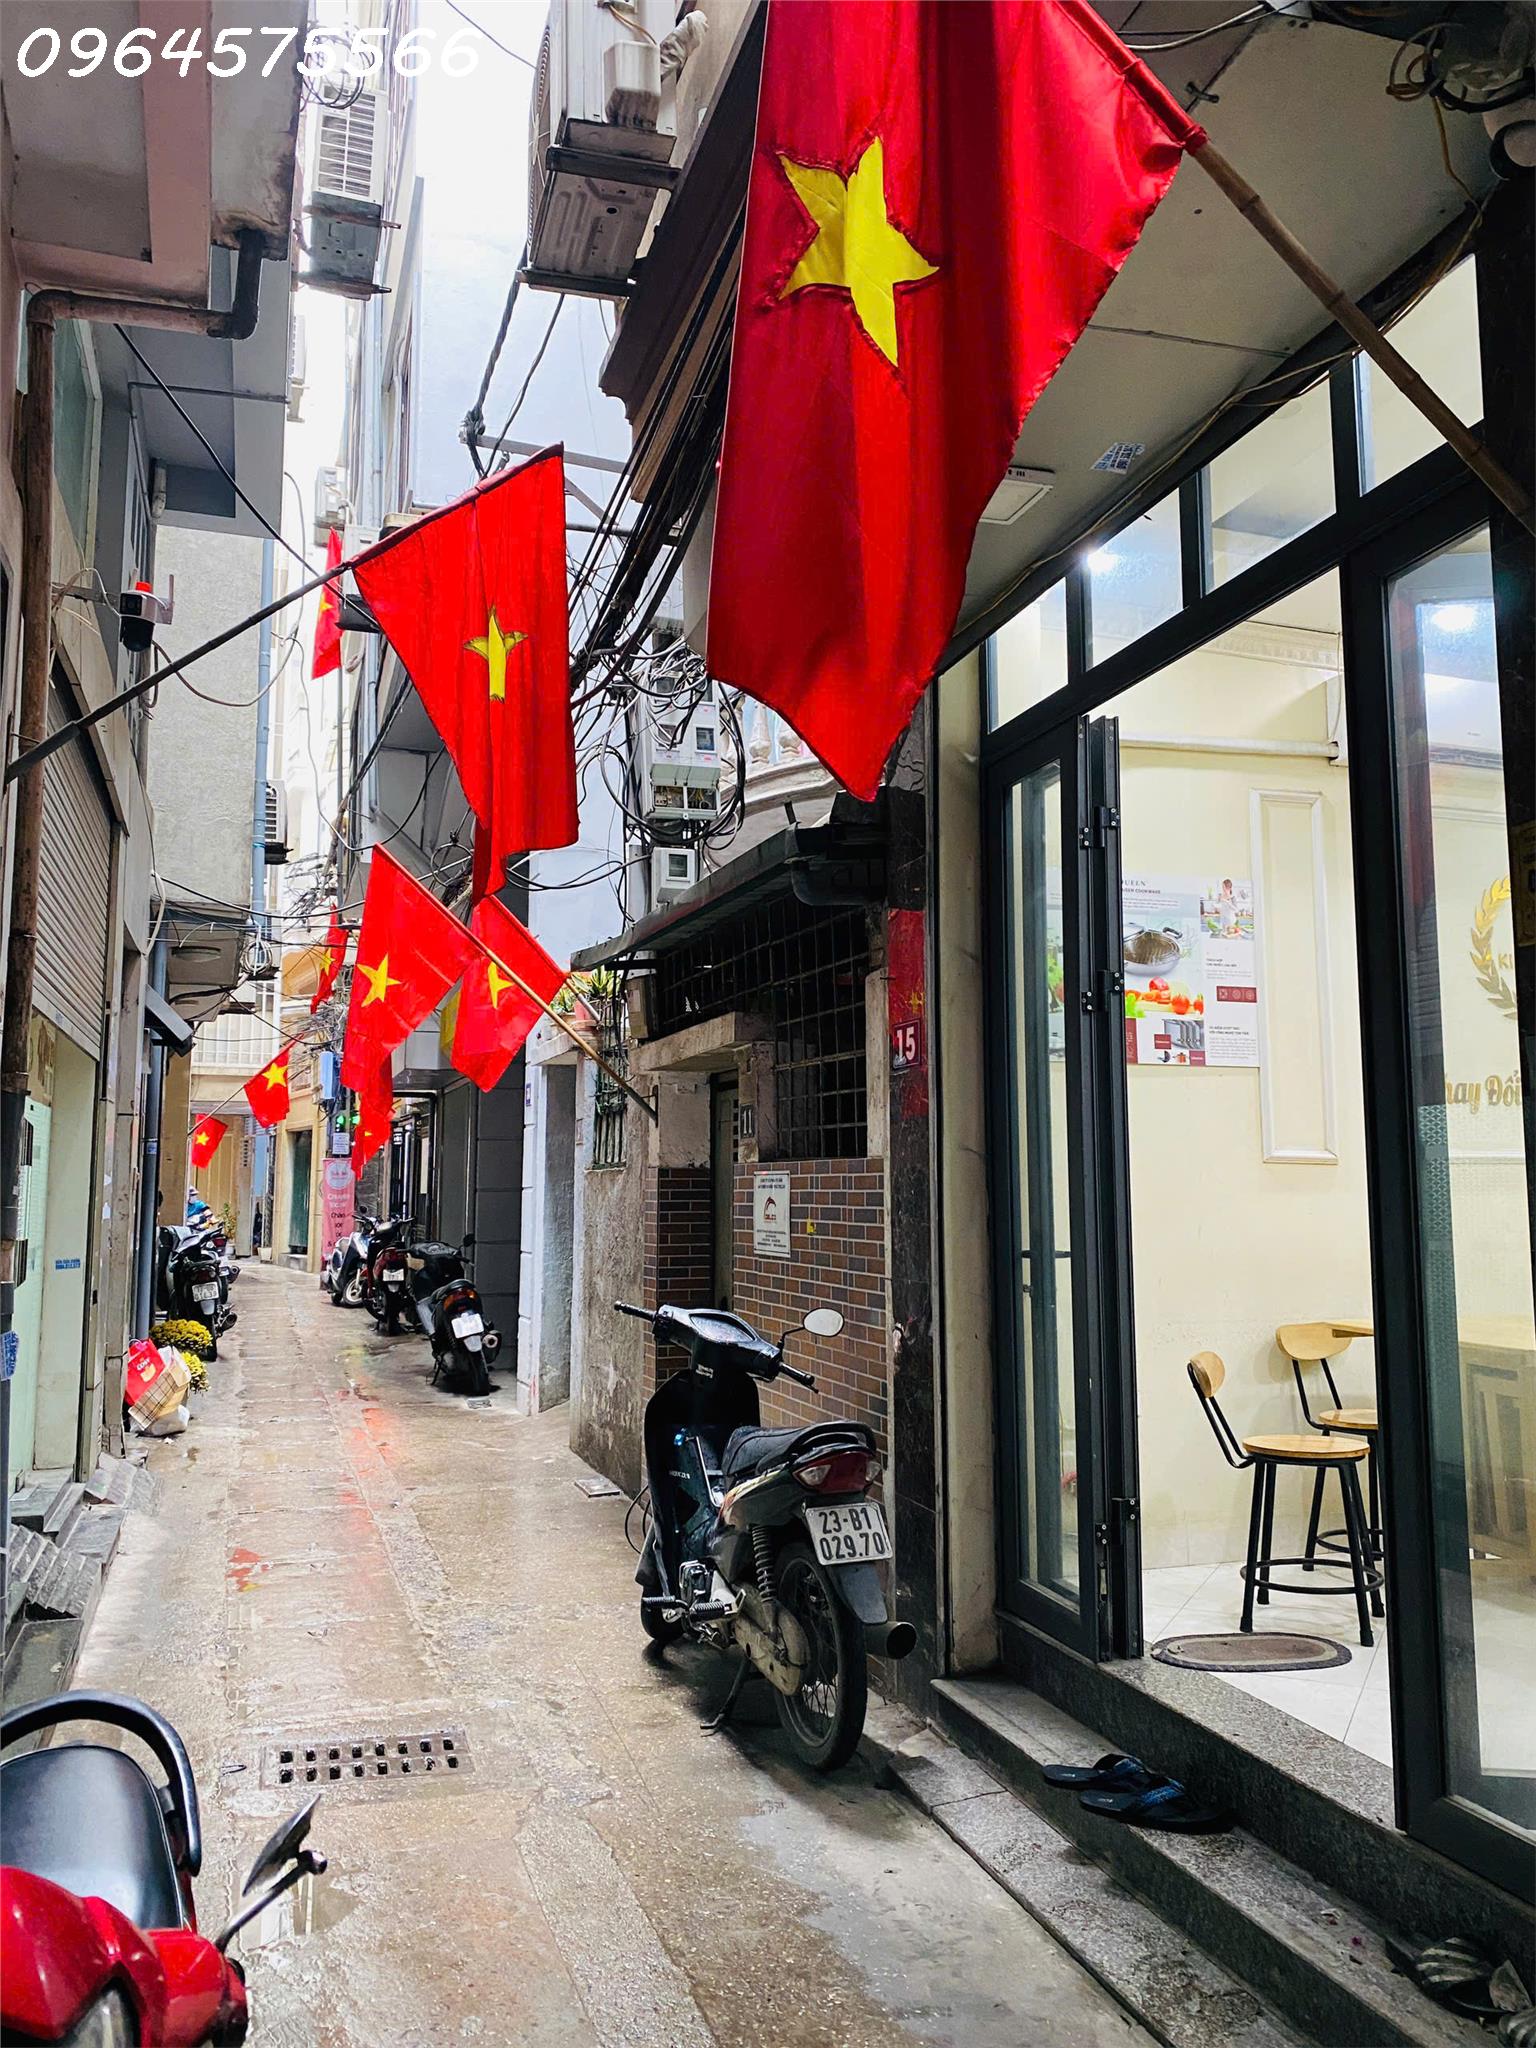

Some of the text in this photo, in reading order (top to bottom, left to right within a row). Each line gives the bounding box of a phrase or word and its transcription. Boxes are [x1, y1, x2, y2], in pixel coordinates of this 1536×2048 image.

[896, 1026, 915, 1061] 15
[818, 1507, 872, 1534] 23-B1
[819, 1531, 885, 1561] 029.70
